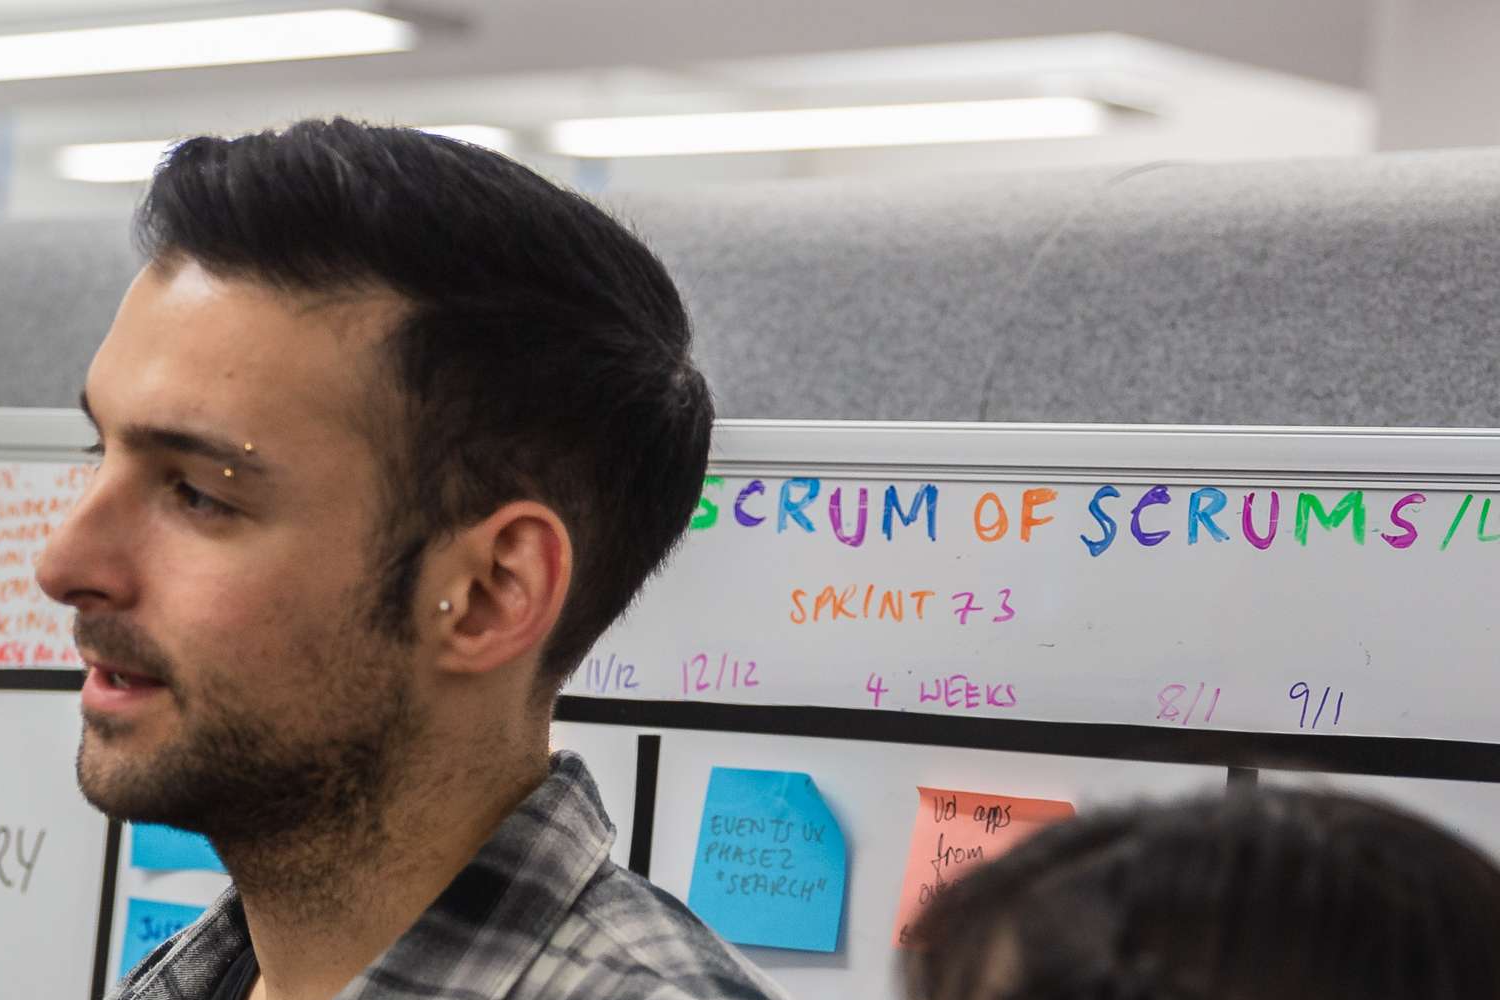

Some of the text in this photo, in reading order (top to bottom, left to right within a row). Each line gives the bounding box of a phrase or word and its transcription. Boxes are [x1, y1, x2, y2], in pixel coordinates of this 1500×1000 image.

[689, 475, 939, 548] SCRUM
[973, 487, 1060, 543] OF
[789, 584, 935, 624] SPRINT
[585, 653, 1344, 729] 11/12 12/12 4 WEEKS 8/1 9/1
[930, 833, 984, 880] from
